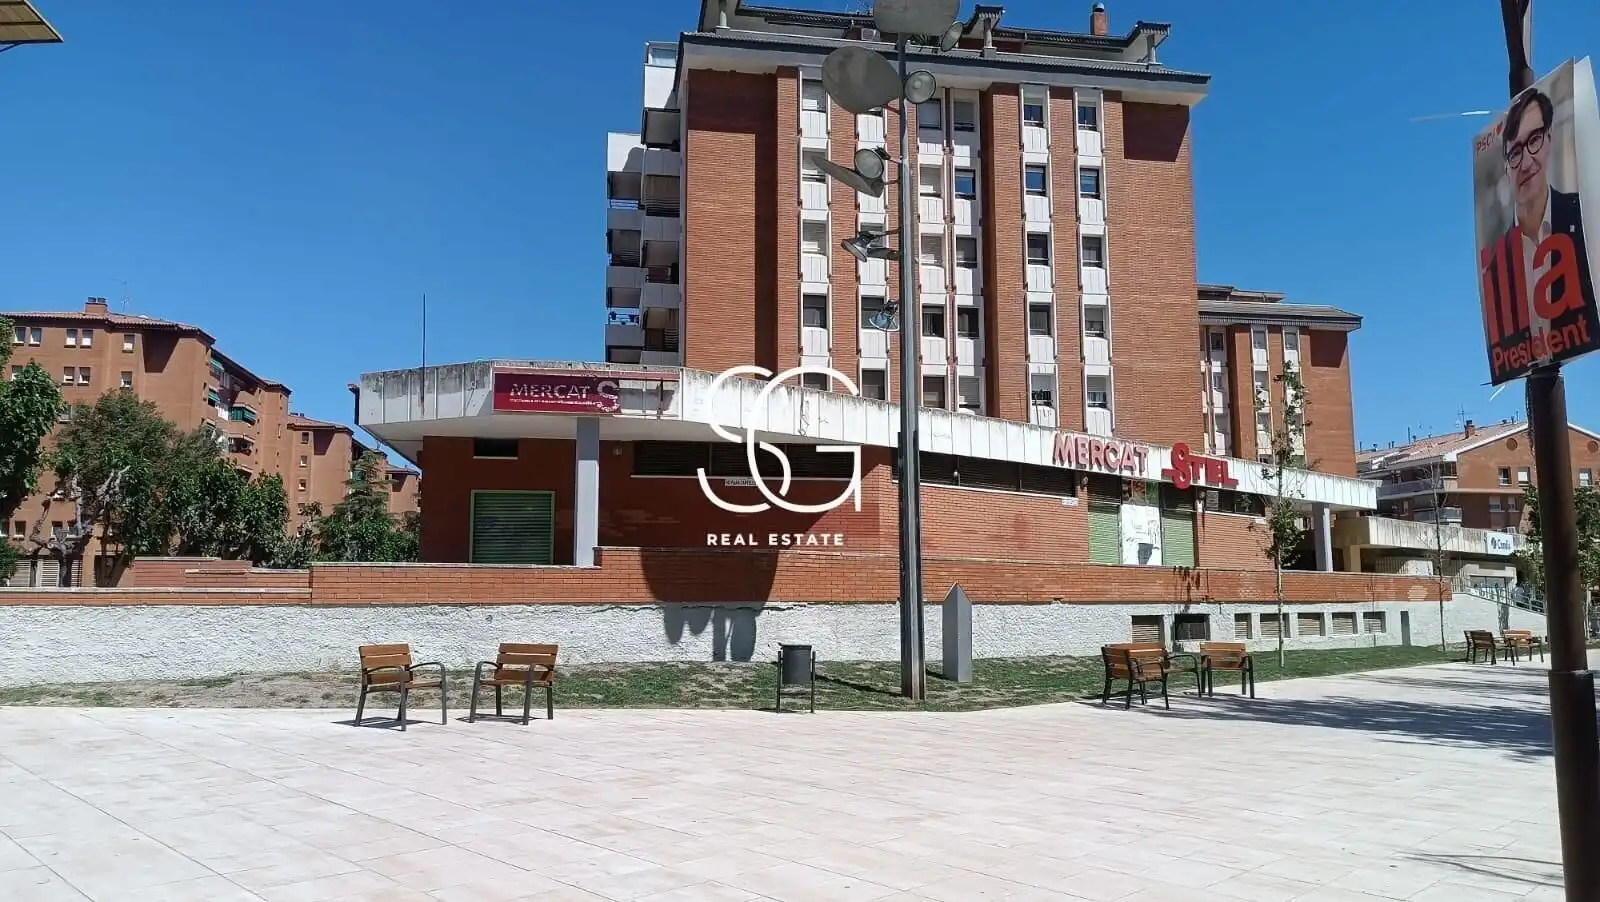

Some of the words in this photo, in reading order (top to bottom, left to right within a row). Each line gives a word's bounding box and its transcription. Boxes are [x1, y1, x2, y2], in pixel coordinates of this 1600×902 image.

[1481, 226, 1586, 345] illa
[1492, 313, 1591, 376] President
[509, 383, 590, 399] MERCAT
[1052, 432, 1148, 477] MERCAT
[1161, 440, 1239, 490] STEL
